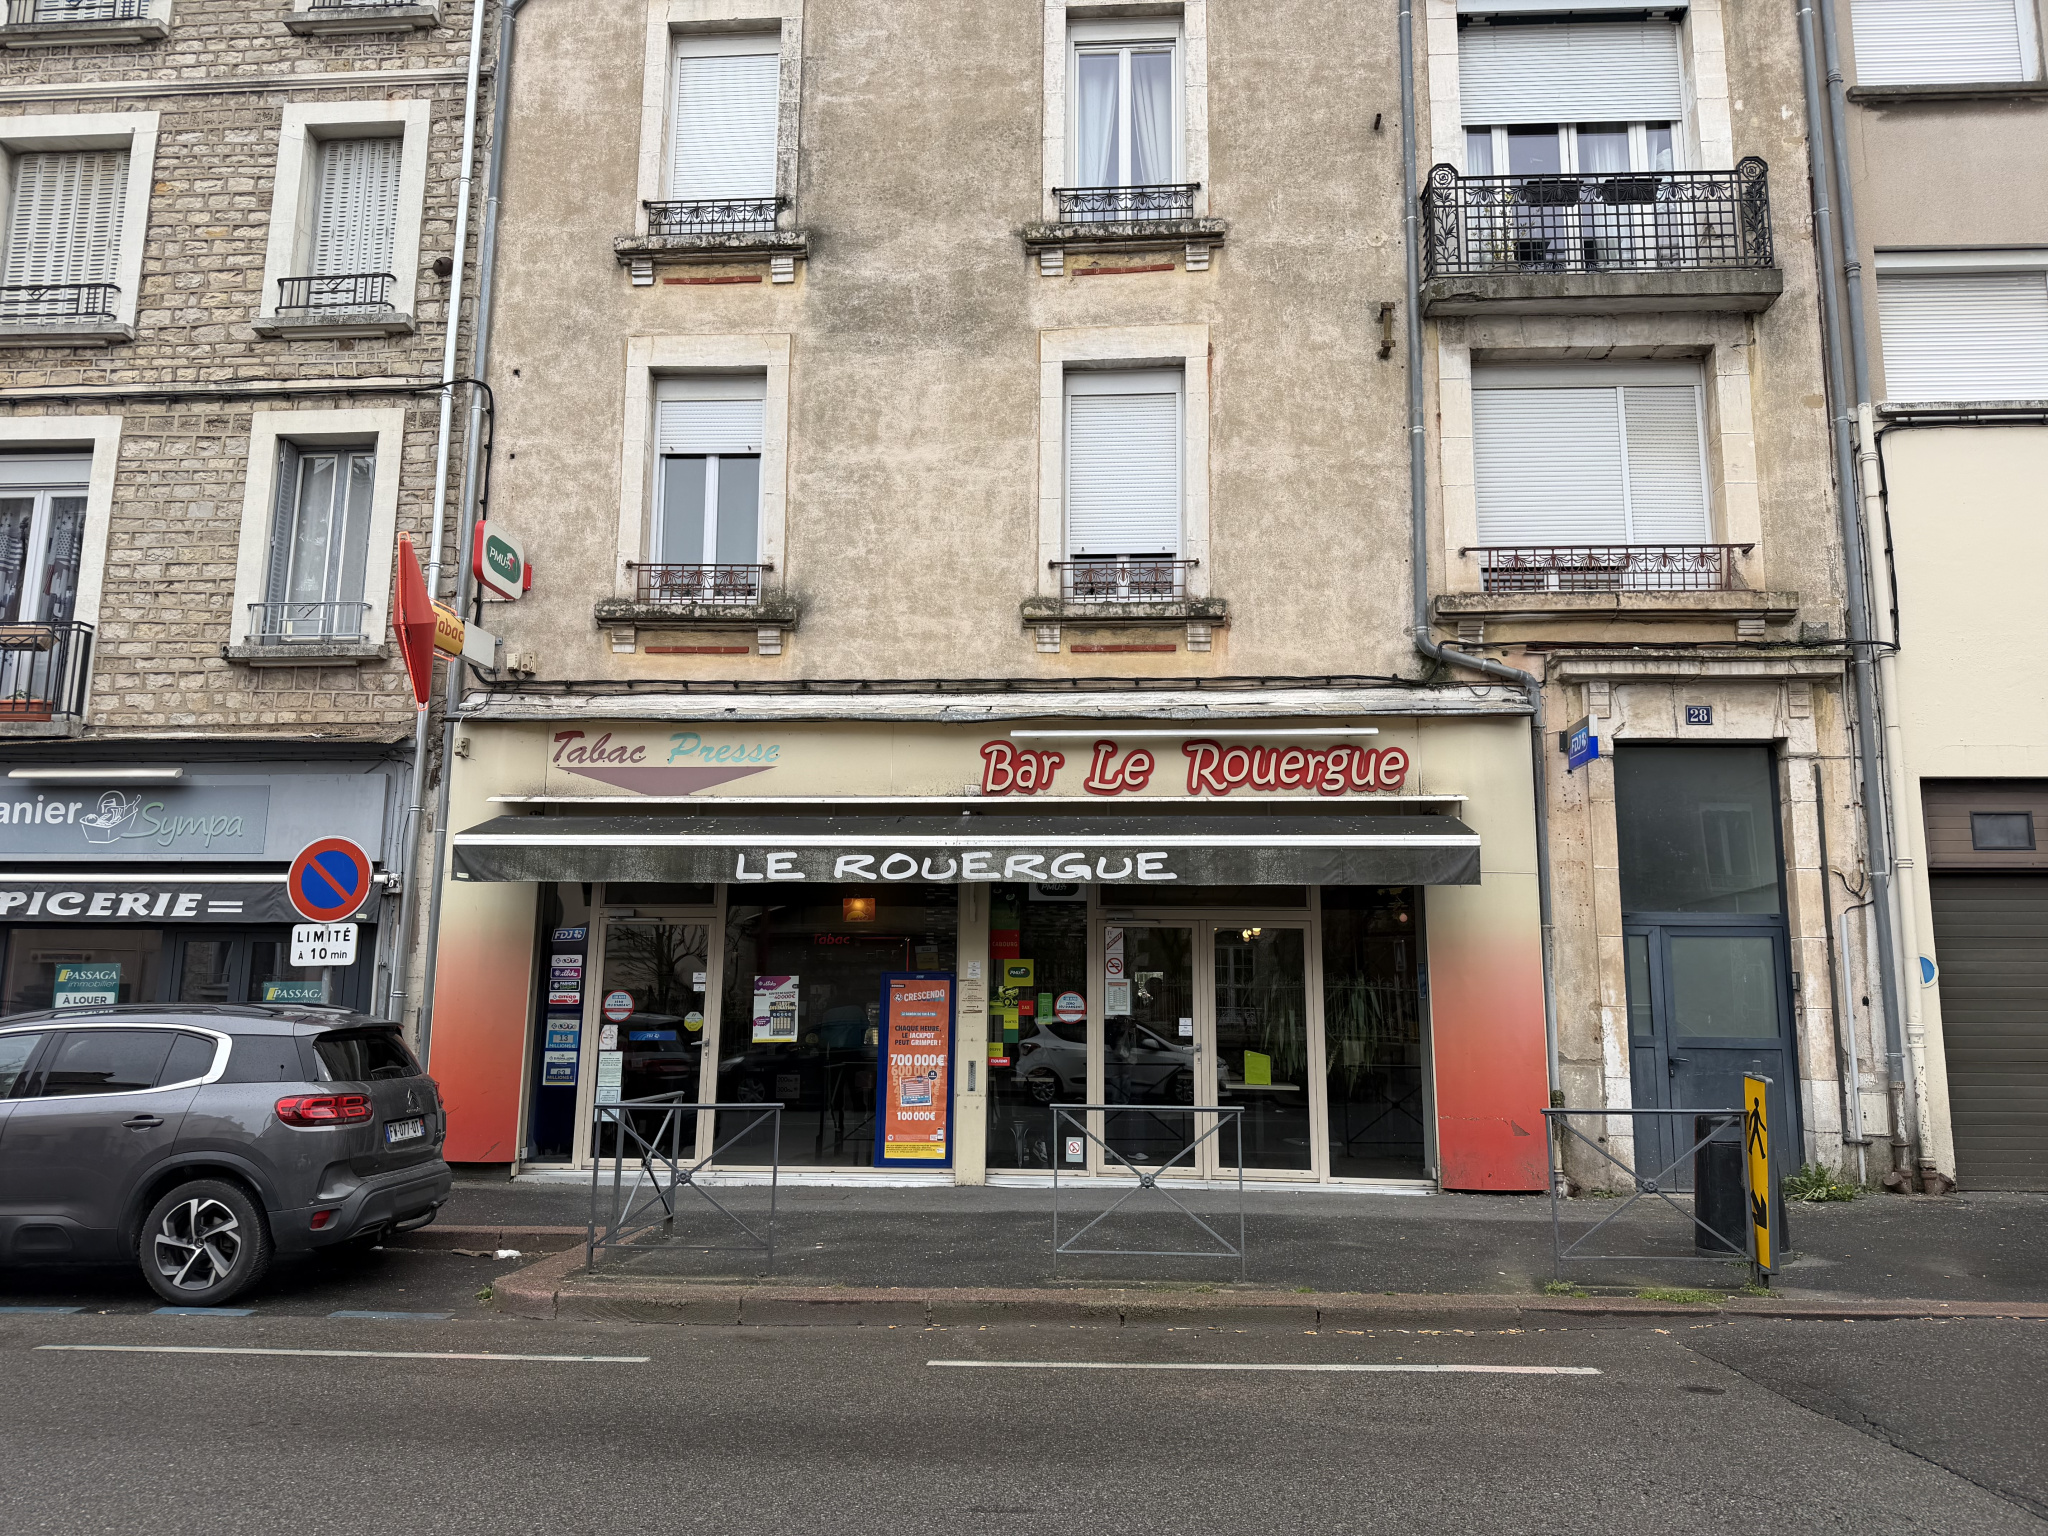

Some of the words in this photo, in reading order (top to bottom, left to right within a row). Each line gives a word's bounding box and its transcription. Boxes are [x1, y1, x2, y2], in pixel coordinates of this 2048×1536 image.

[489, 546, 507, 566] PMU
[434, 612, 464, 643] Tabac
[1690, 708, 1708, 723] 28
[553, 731, 646, 764] Tabac
[667, 732, 780, 764] Presse
[1571, 734, 1583, 755] FDJ
[982, 742, 1062, 795] Bar
[1086, 742, 1152, 792] Le
[1184, 741, 1407, 793] Rouergue
[121, 801, 243, 848] Sympa
[736, 852, 806, 881] LE
[834, 852, 1178, 881] ROUERGUE
[297, 927, 351, 943] LIMITÉ
[554, 931, 574, 939] FDJ
[814, 933, 852, 945] Tabac
[298, 950, 304, 960] À
[311, 947, 327, 960] 10
[331, 950, 348, 960] min
[66, 971, 117, 980] PASSAGA
[68, 980, 116, 988] immobilier
[63, 995, 70, 1004] À
[74, 996, 107, 1004] LOUER
[274, 989, 322, 998] PASSAG
[904, 989, 945, 1001] CRESCENDO
[558, 1034, 569, 1042] 13
[890, 1054, 913, 1066] 700
[896, 1111, 913, 1121] 100
[914, 1111, 936, 1121] 000€
[389, 1120, 420, 1138] FW-077-QT
